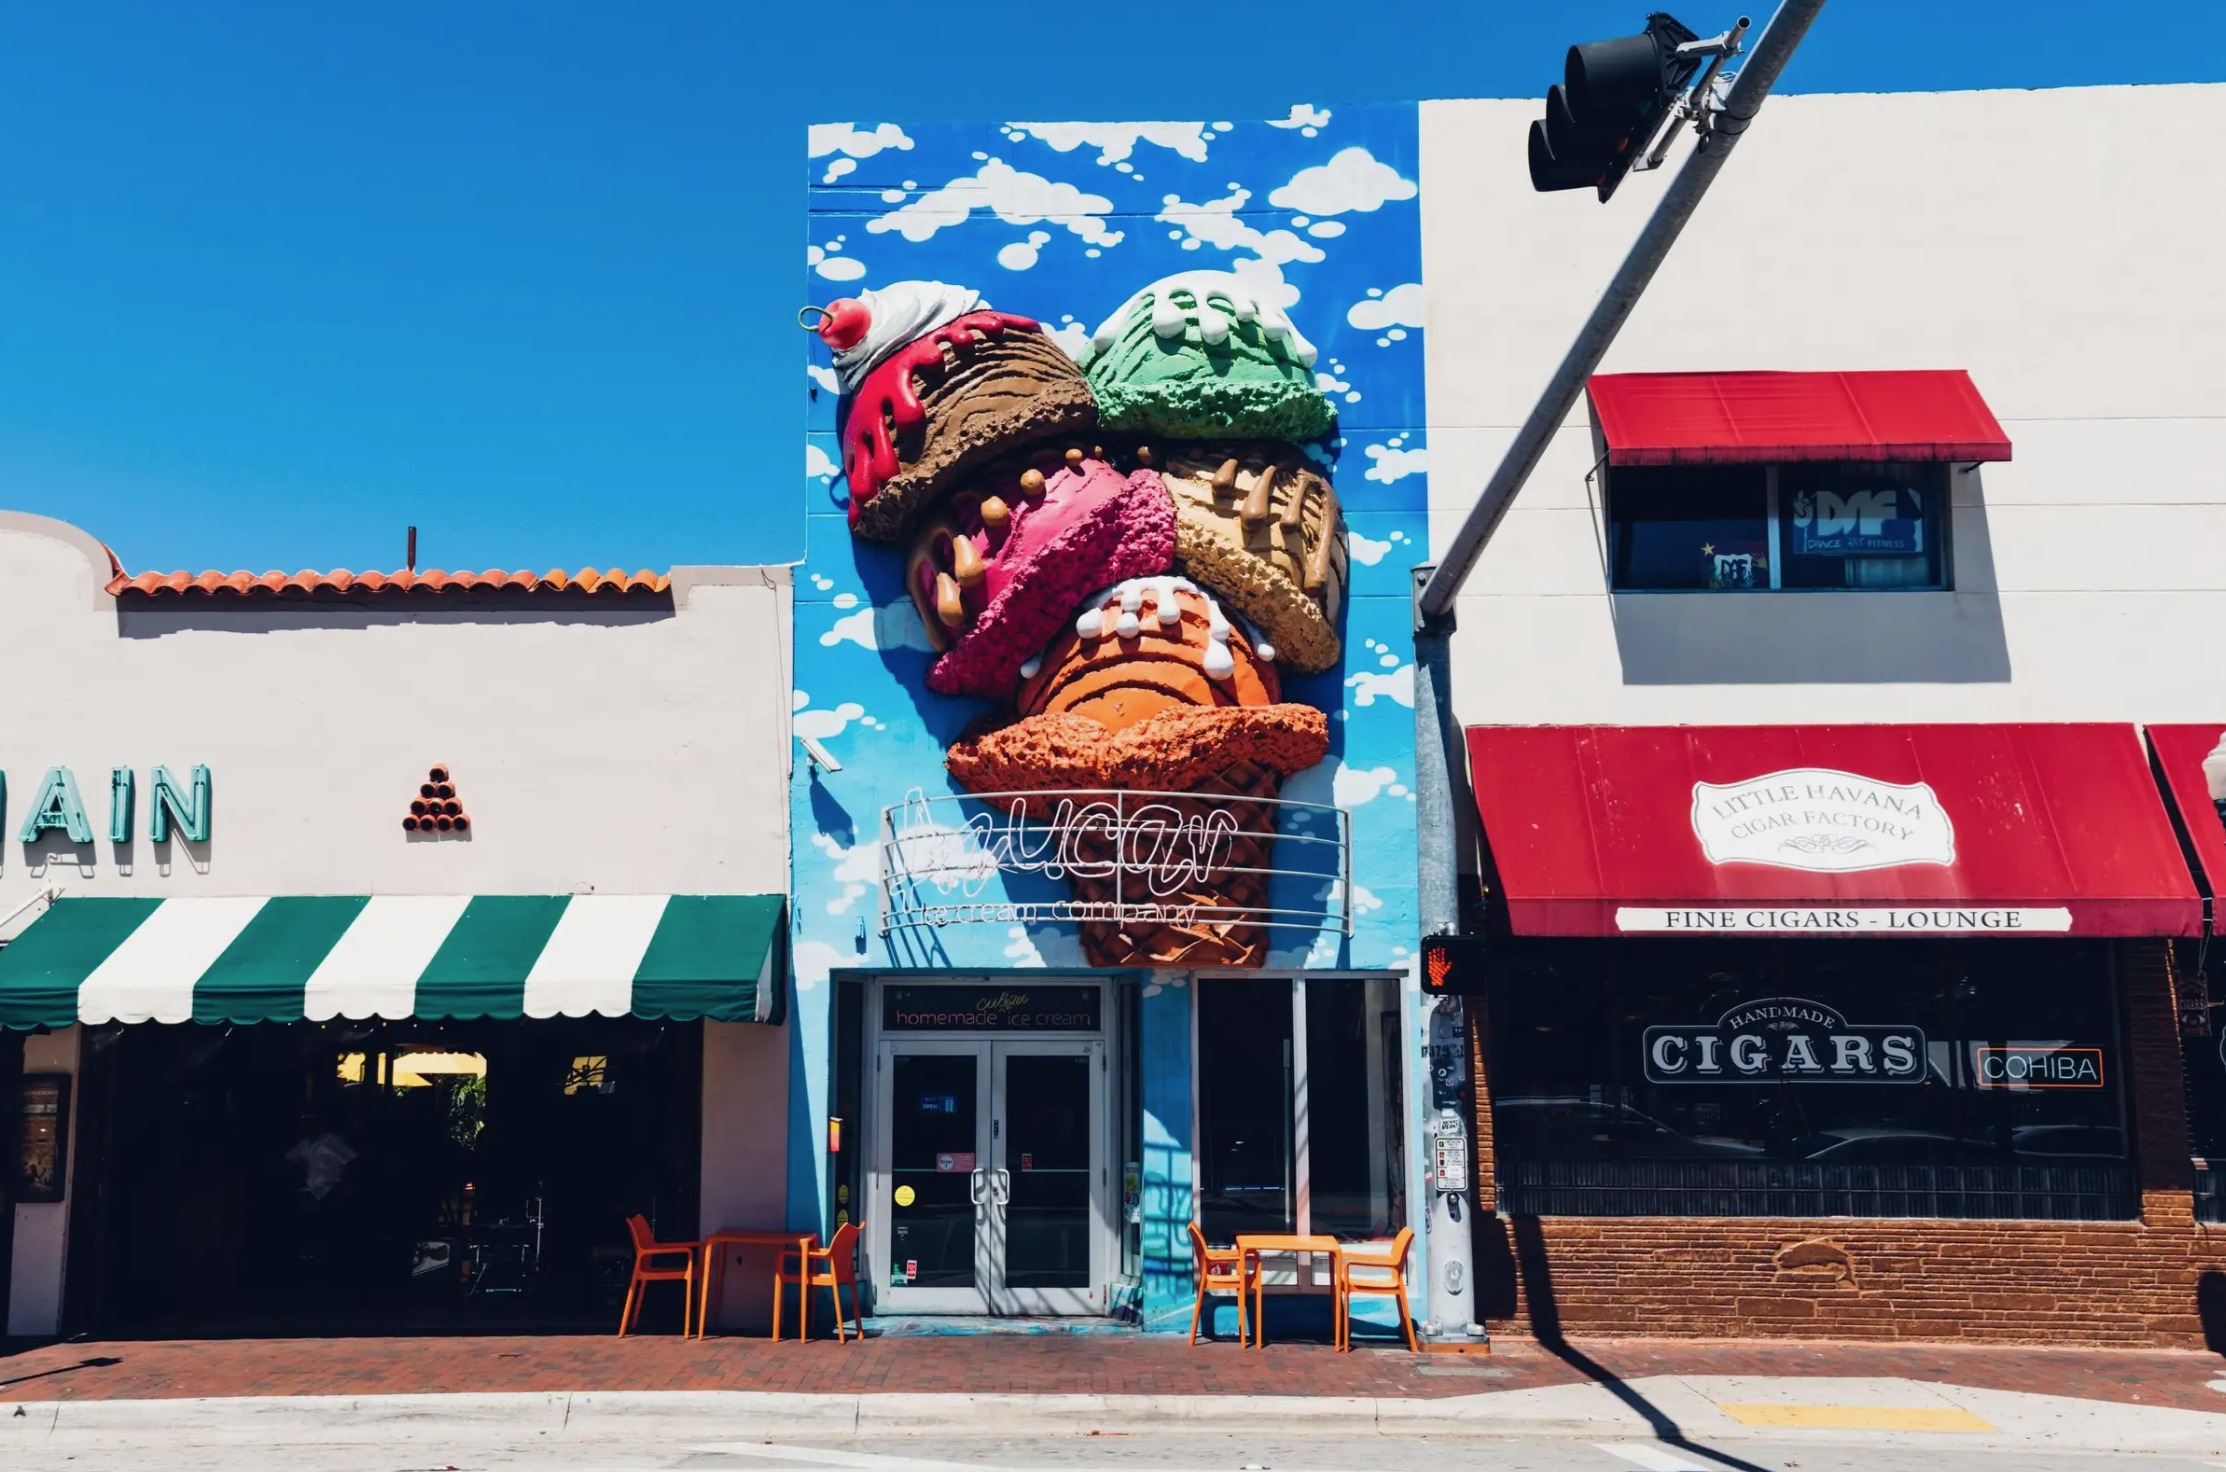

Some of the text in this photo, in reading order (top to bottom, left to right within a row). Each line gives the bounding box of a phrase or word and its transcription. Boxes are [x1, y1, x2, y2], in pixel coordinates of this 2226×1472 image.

[1807, 538, 1842, 550] DANCE
[1867, 539, 1906, 549] FITNESS
[0, 765, 213, 843] AIN
[1710, 784, 1922, 820] LITTLE HAVANA
[1730, 810, 1915, 841] CIGAR FACTORY
[956, 904, 1038, 923] cream
[1051, 900, 1199, 930] company
[1664, 910, 1737, 929] FINE
[1746, 910, 1860, 930] CIGARS
[1888, 910, 2023, 930] LOUNGE
[896, 1010, 1091, 1026] homemade ice cream
[1729, 1006, 1836, 1030] HANDMADE
[2179, 998, 2205, 1011] CIGARS
[1651, 1034, 1918, 1076] CIGARS
[1984, 1054, 2099, 1081] COHIBA
